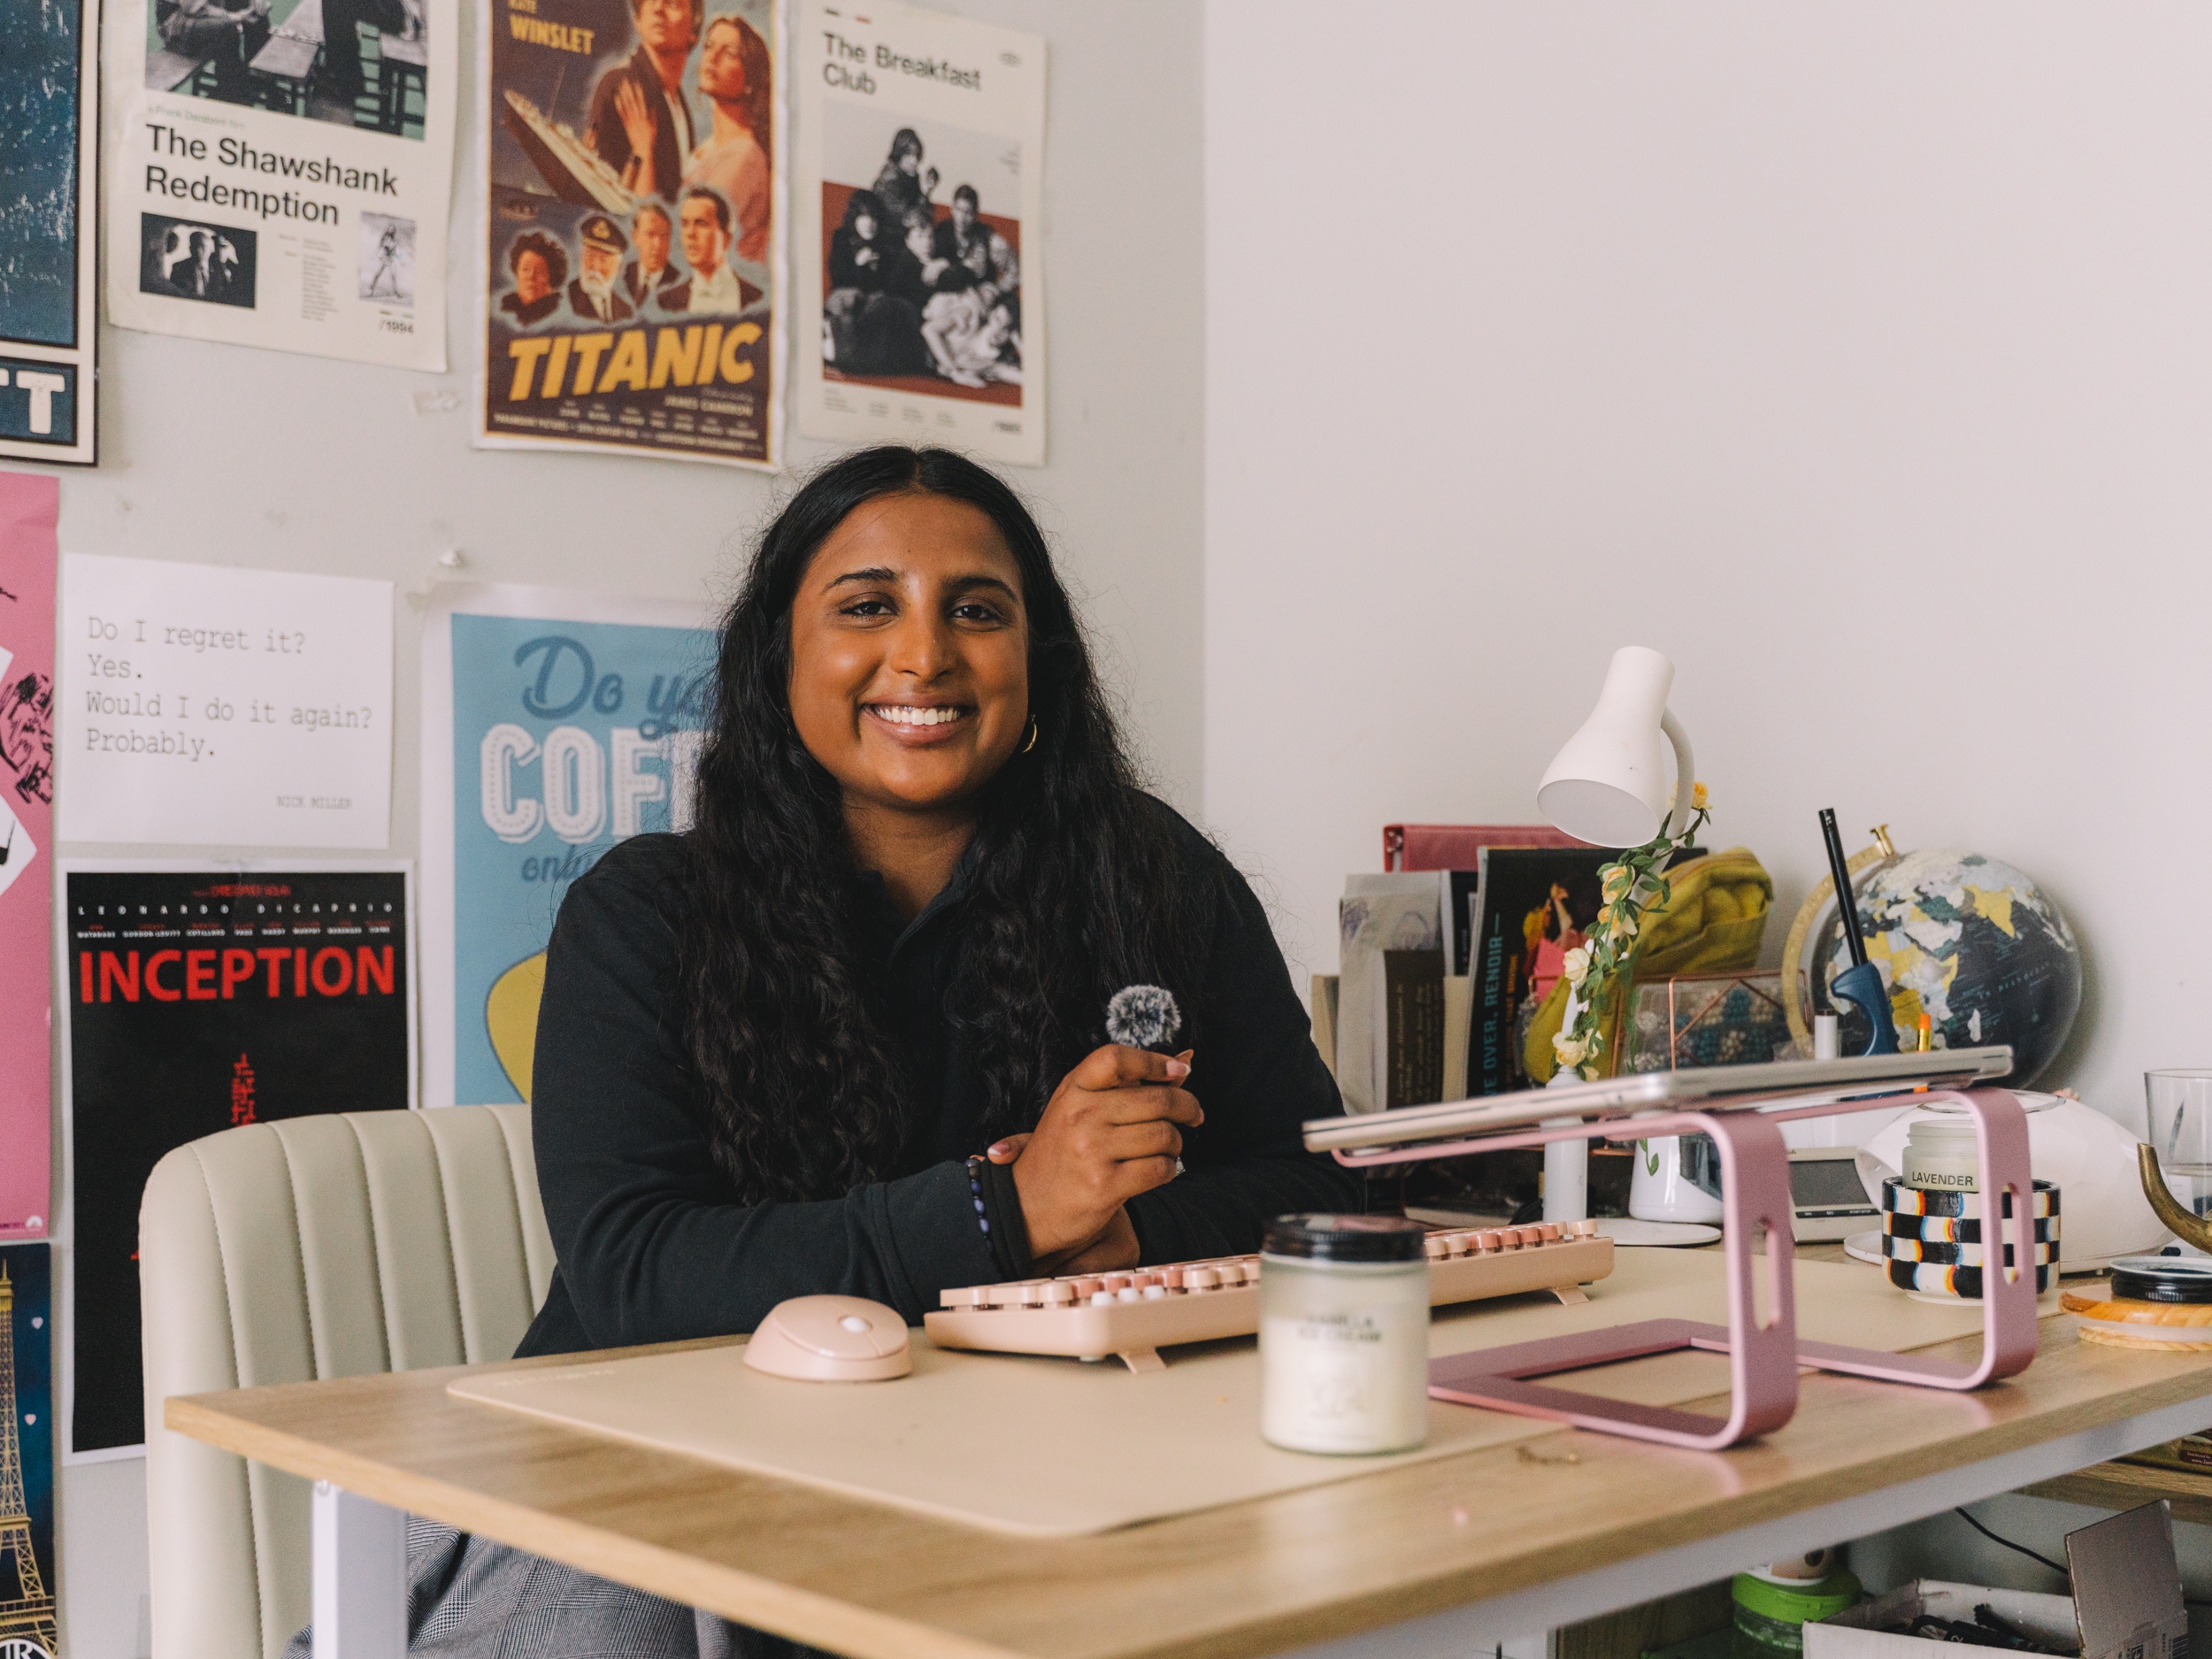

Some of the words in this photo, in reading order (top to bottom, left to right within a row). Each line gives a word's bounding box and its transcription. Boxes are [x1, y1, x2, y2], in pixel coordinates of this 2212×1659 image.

[510, 13, 595, 55] WINSLET
[823, 32, 866, 64] The
[876, 44, 982, 92] Breakfast
[823, 63, 877, 95] Club
[146, 124, 207, 161] The
[218, 137, 399, 197] Shawshank
[146, 165, 341, 227] Redemption
[509, 321, 763, 402] TITANIC
[88, 617, 119, 641] Do
[134, 620, 147, 642] I
[164, 627, 250, 653] regret
[265, 631, 306, 655] it?
[87, 653, 142, 680] Yes.
[513, 634, 625, 721] Do
[86, 690, 162, 718] Would
[178, 695, 190, 719] I
[205, 697, 235, 722] do
[250, 699, 278, 725] it
[290, 704, 373, 733] again?
[87, 726, 215, 763] Probably.
[80, 944, 395, 1004] INCEPTION
[1912, 1171, 1973, 1187] LAVENDER
